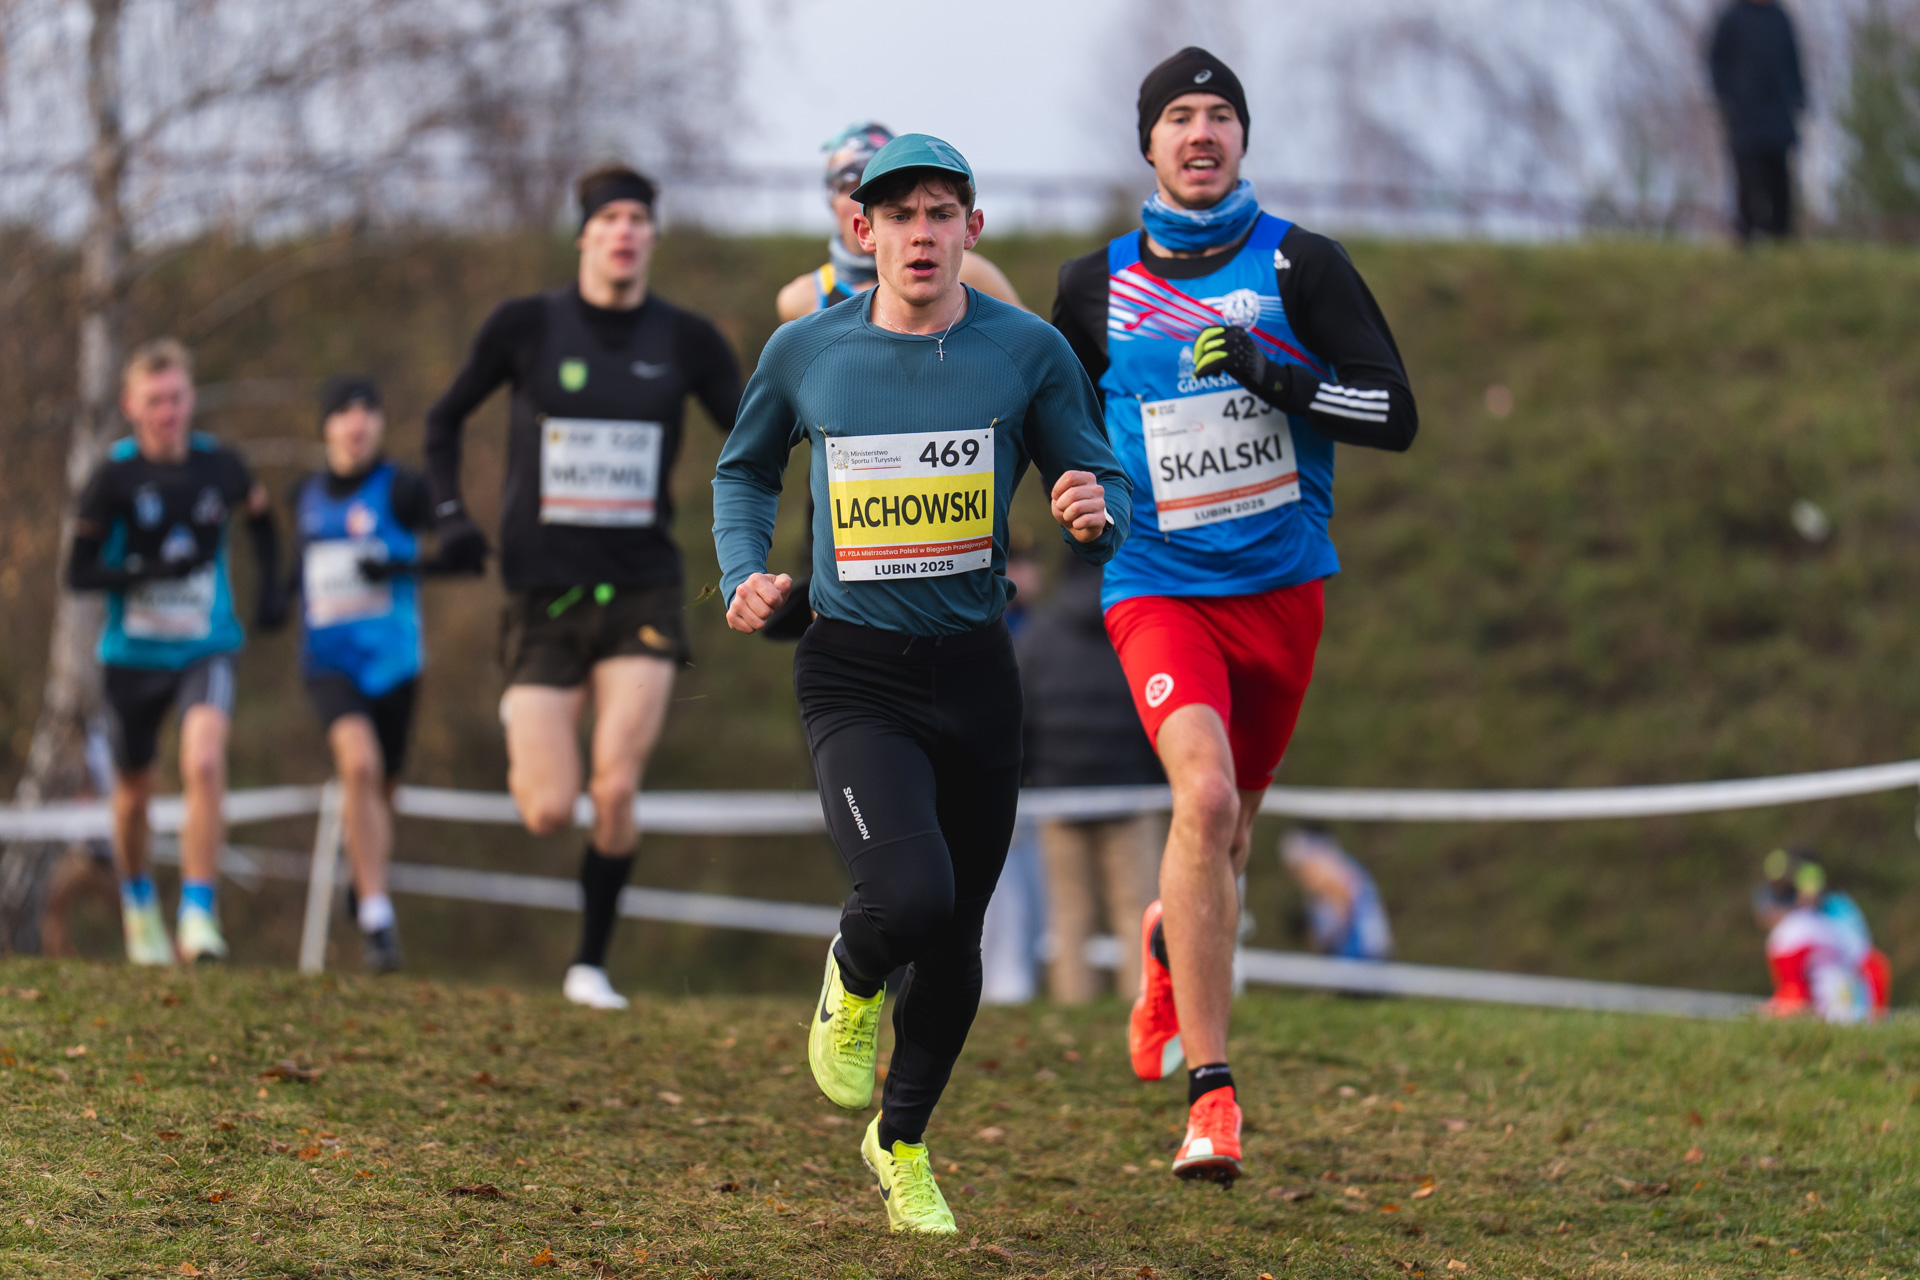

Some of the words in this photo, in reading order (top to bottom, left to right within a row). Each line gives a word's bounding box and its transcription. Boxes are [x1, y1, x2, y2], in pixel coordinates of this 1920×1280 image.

[874, 456, 901, 464] Turystyki
[918, 438, 980, 468] 469
[1160, 433, 1282, 482] SKALSKI
[835, 489, 987, 529] LACHOWSKI
[1194, 504, 1232, 521] LUBIN
[899, 547, 918, 555] Polski
[926, 546, 952, 554] Biegach
[874, 563, 917, 576] LUBIN
[920, 560, 954, 573] 2025
[843, 786, 871, 840] SALOMON
